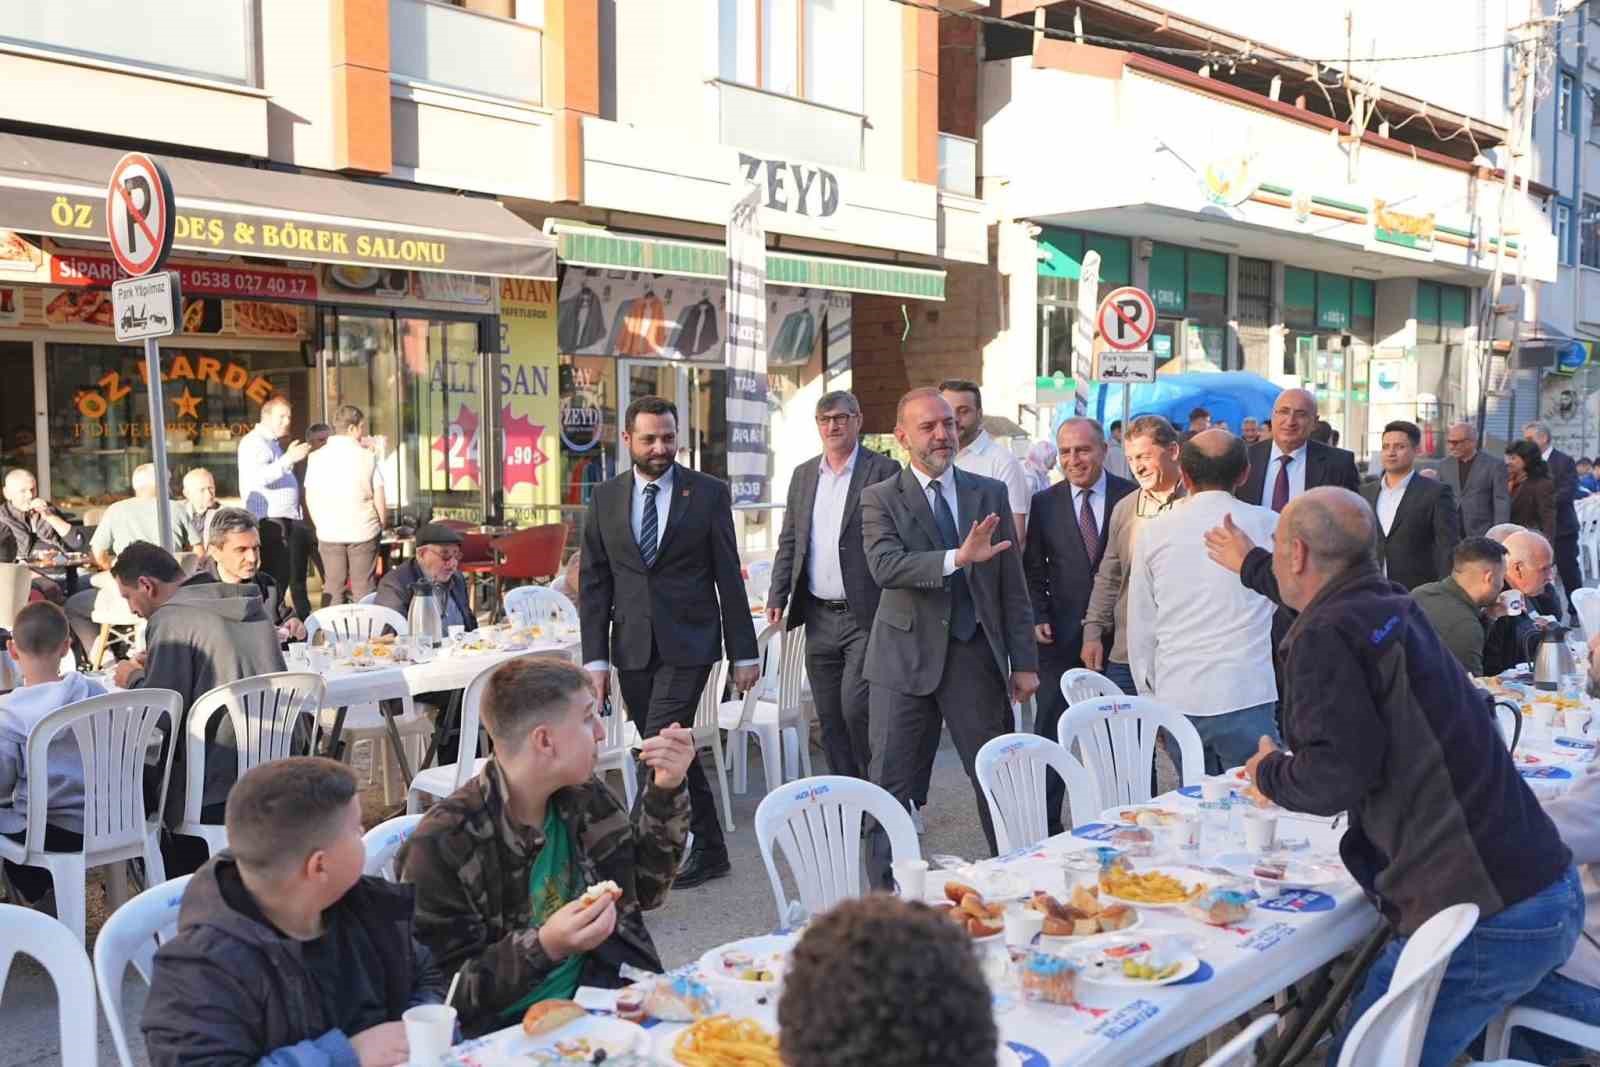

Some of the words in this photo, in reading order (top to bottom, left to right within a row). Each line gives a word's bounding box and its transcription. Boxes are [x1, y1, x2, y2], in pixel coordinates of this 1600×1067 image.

[738, 152, 840, 217] ZEYD
[51, 196, 93, 228] ÖZ
[174, 216, 225, 245] DEŞ
[233, 222, 255, 245] &
[263, 222, 349, 254] BÖREK
[356, 235, 446, 263] SALONU
[191, 271, 230, 288] 0538
[235, 274, 263, 290] 027
[267, 277, 286, 293] 40
[289, 279, 307, 295] 17
[500, 277, 552, 303] AYAN
[76, 368, 132, 418] ÖZ
[136, 354, 276, 405] KARDE
[562, 408, 600, 425] ZEYD
